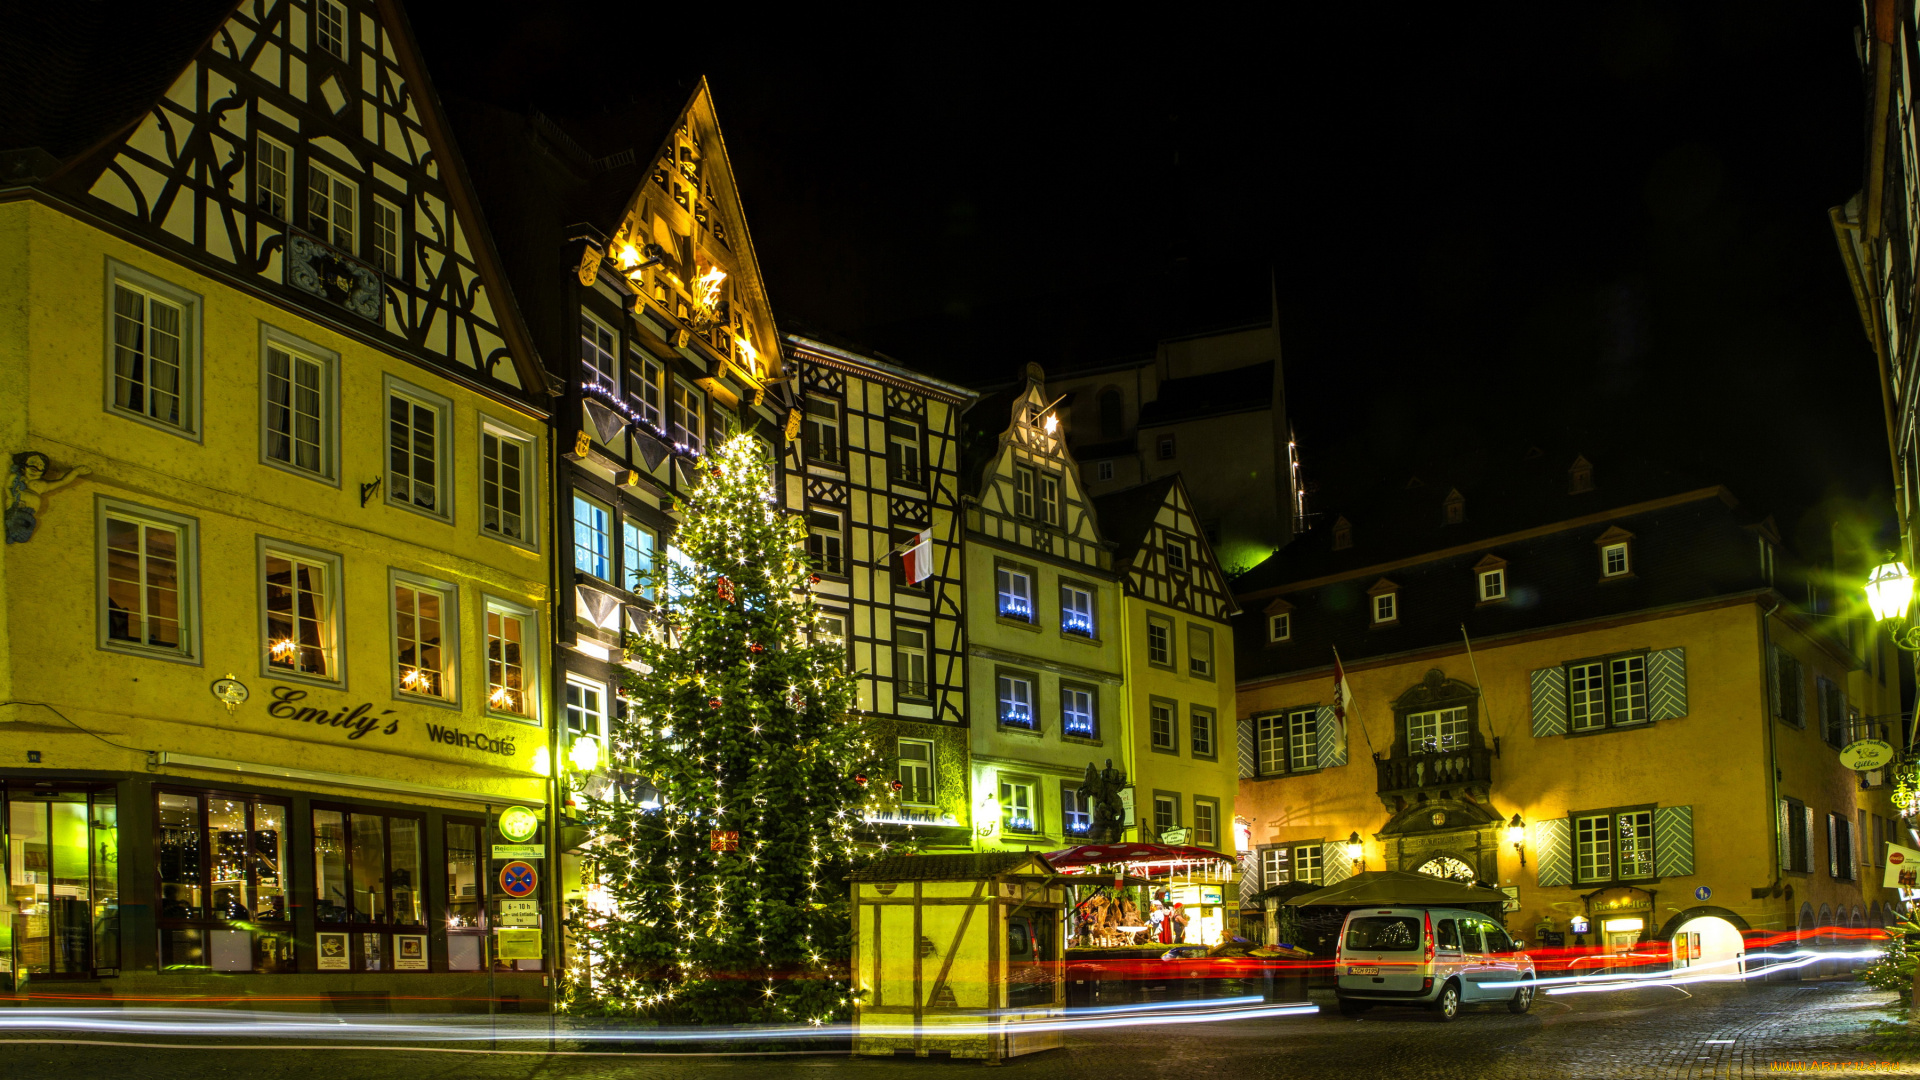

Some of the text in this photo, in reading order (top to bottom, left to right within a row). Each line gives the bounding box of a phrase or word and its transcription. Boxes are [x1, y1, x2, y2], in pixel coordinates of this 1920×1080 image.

[426, 722, 516, 757] Wein-Café
[1853, 760, 1880, 770] Gilles
[899, 808, 937, 823] Markt
